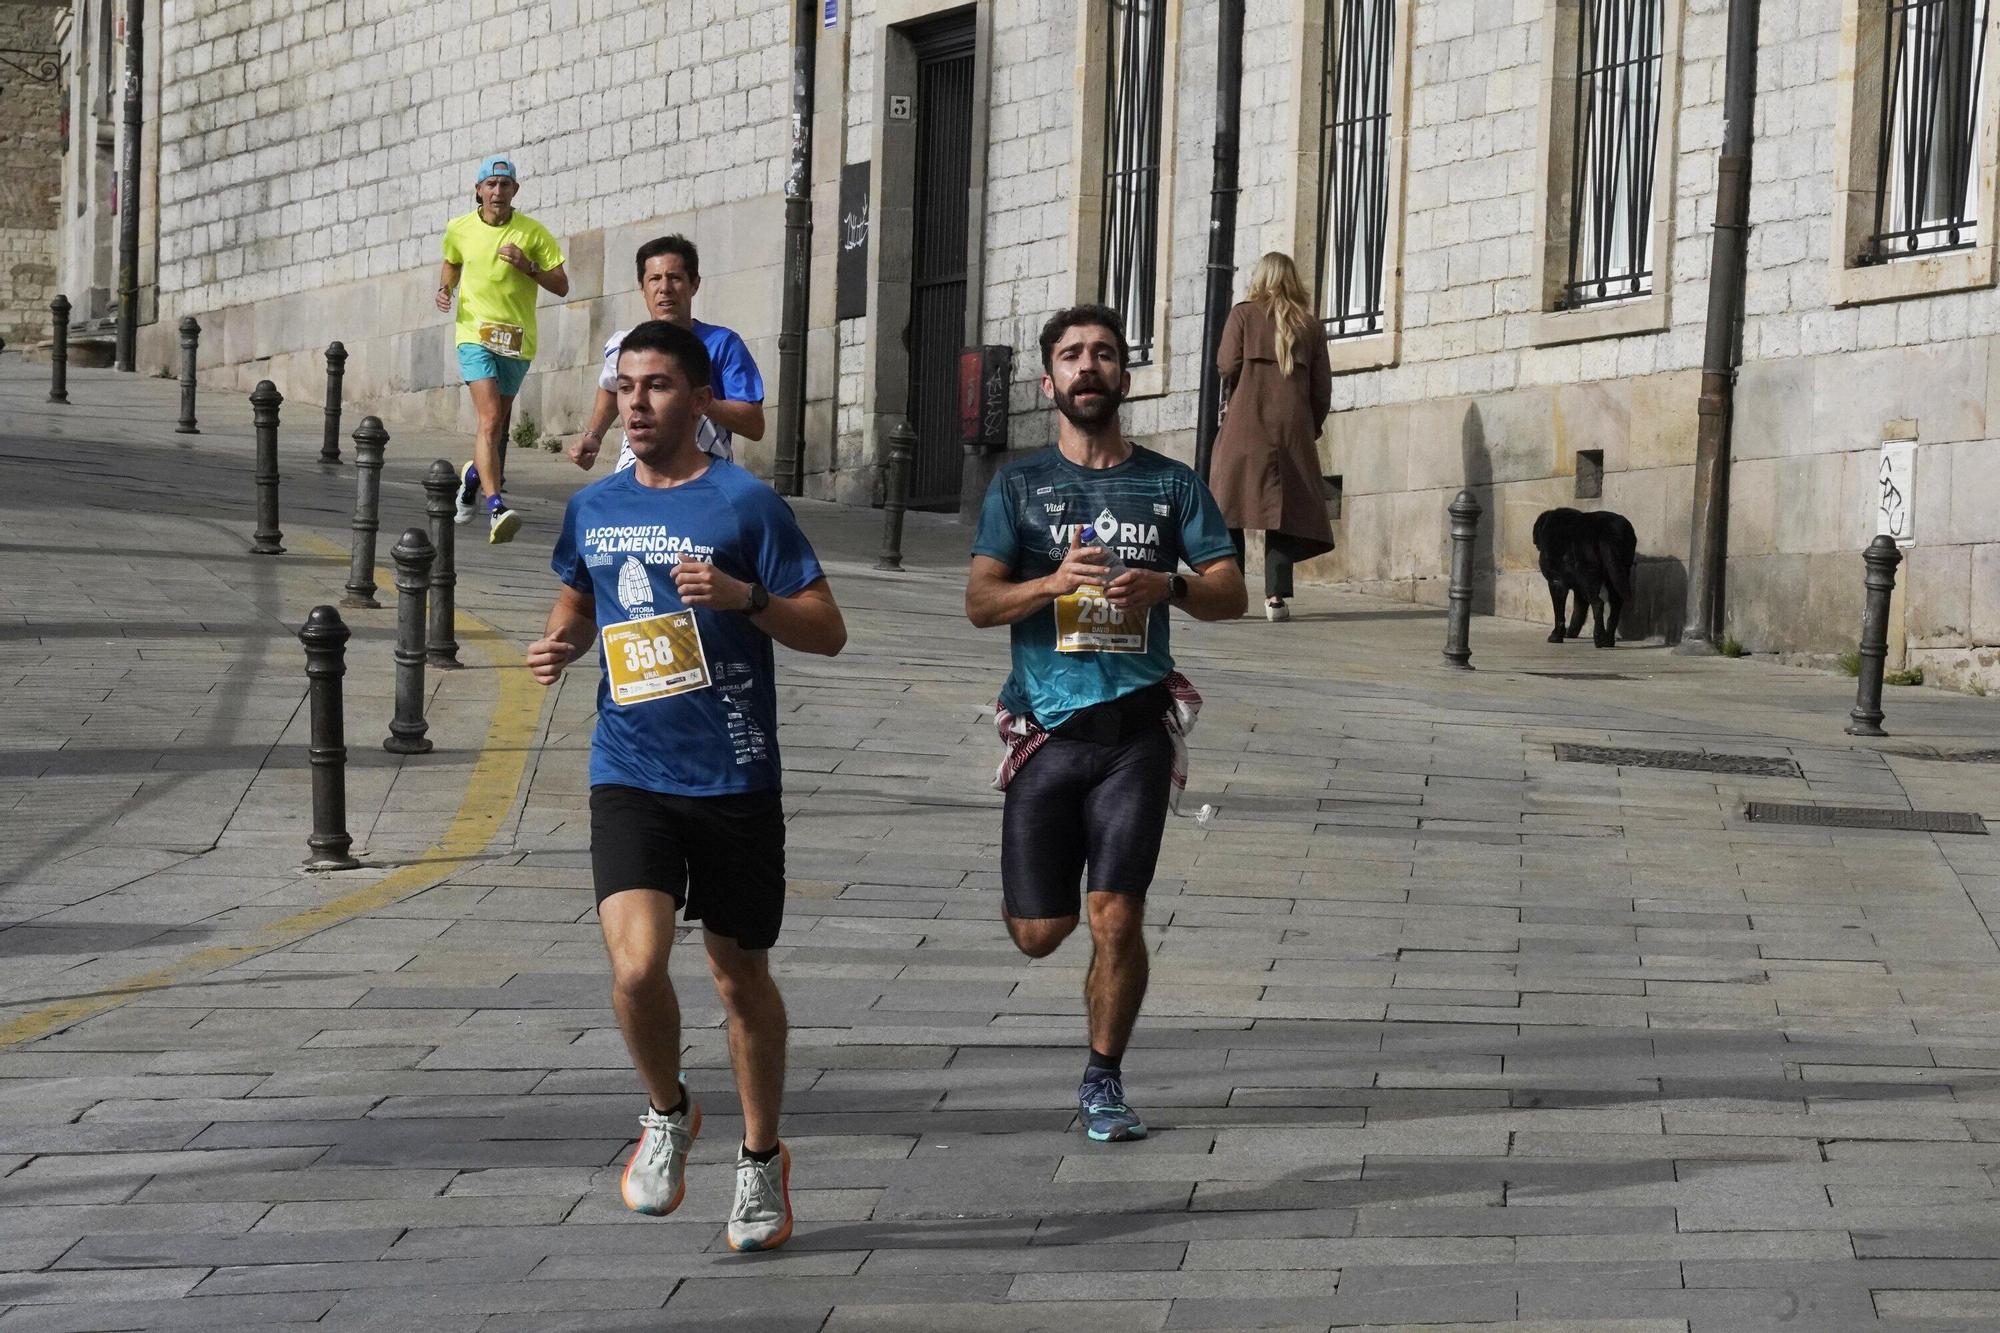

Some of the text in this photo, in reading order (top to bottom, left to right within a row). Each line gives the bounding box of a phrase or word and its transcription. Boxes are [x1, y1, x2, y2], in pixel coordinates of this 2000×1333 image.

[490, 330, 512, 345] 319
[1044, 502, 1066, 513] Vital
[586, 525, 667, 539] LA CONQUISTA
[584, 538, 592, 547] DE
[596, 537, 693, 553] ALMENDRA
[694, 545, 714, 555] REN
[1117, 546, 1158, 562] TRAIL
[673, 617, 688, 629] 10K
[624, 635, 674, 672] 358
